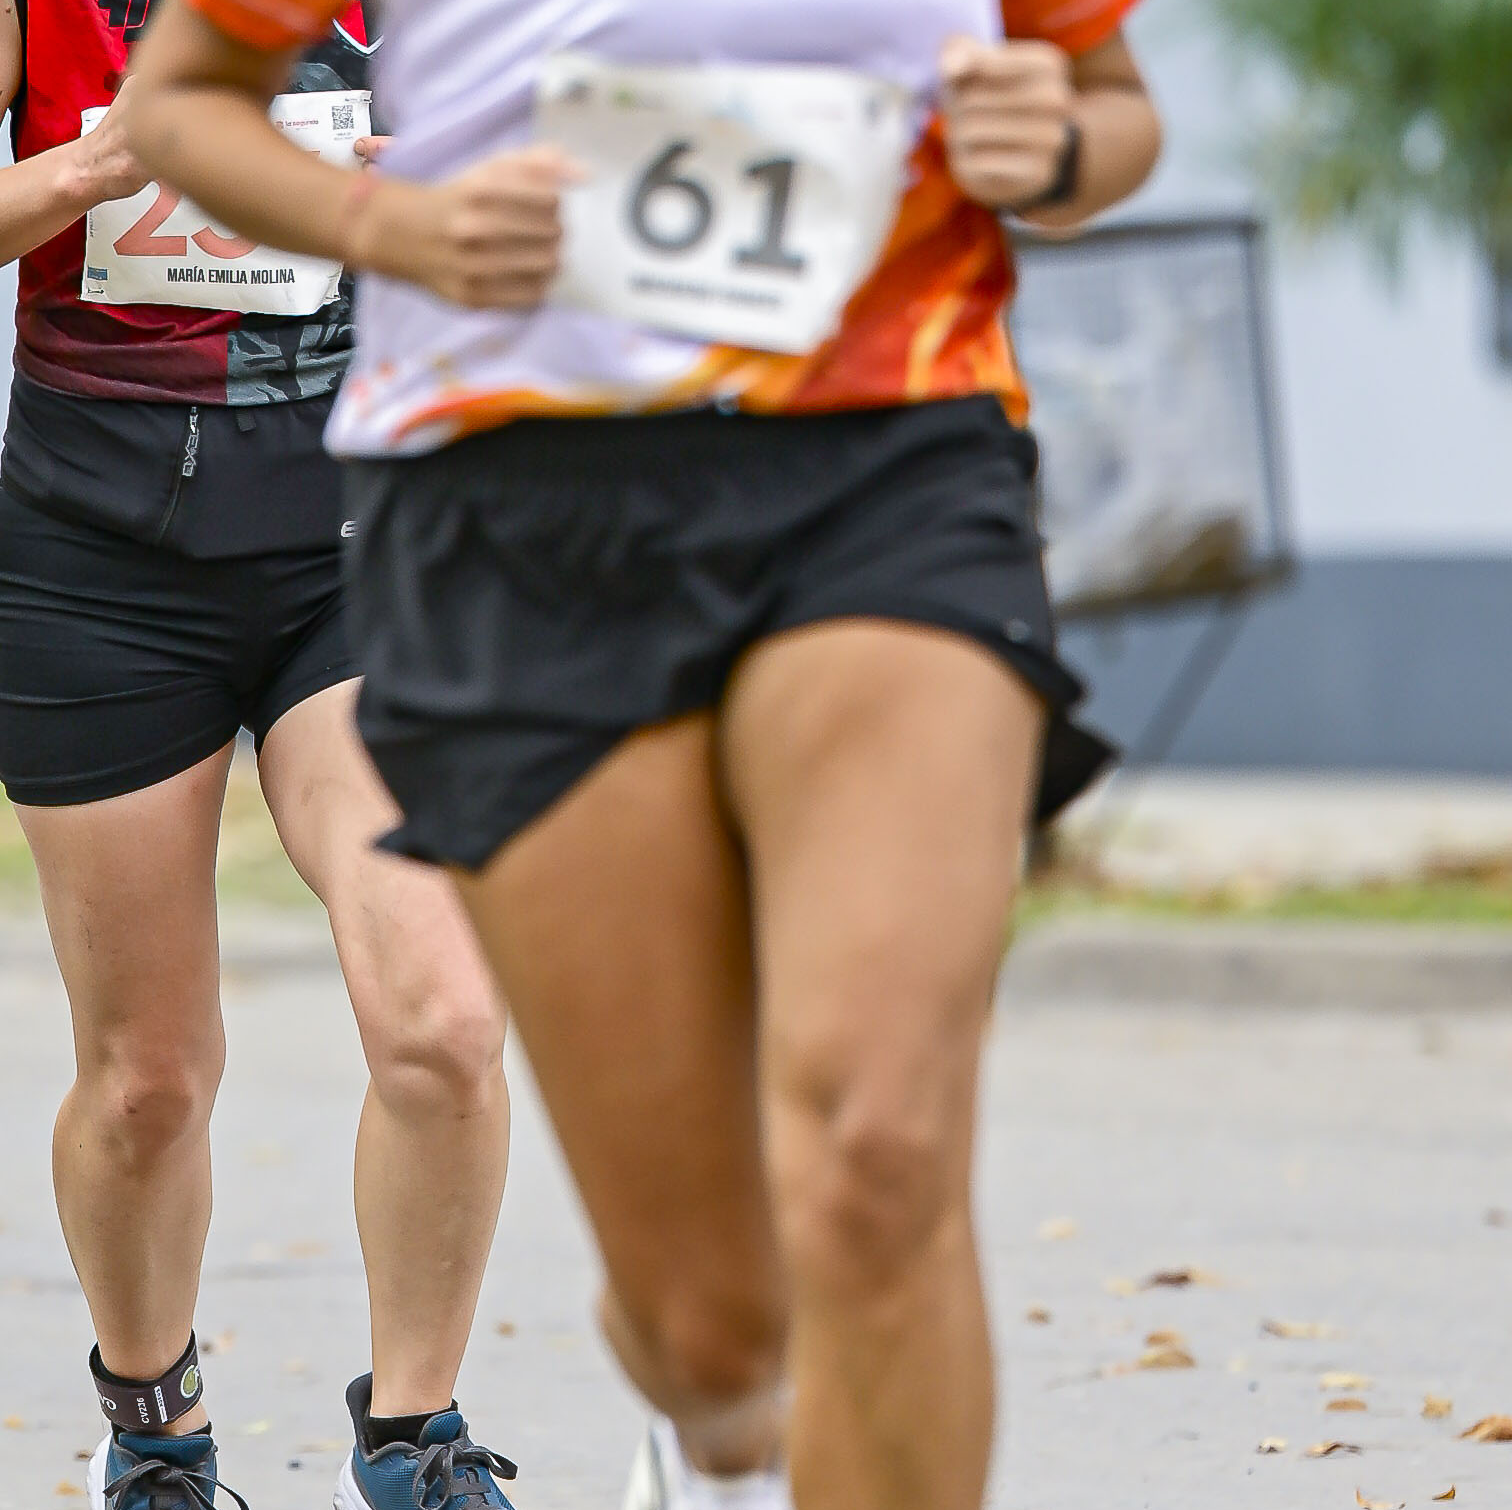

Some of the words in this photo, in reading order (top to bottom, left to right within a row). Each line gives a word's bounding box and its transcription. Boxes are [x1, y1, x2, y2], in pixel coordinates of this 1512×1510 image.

[624, 138, 808, 271] 61
[167, 265, 205, 283] MARÍA
[208, 269, 248, 284] EMILIA
[250, 269, 295, 285] MOLINA
